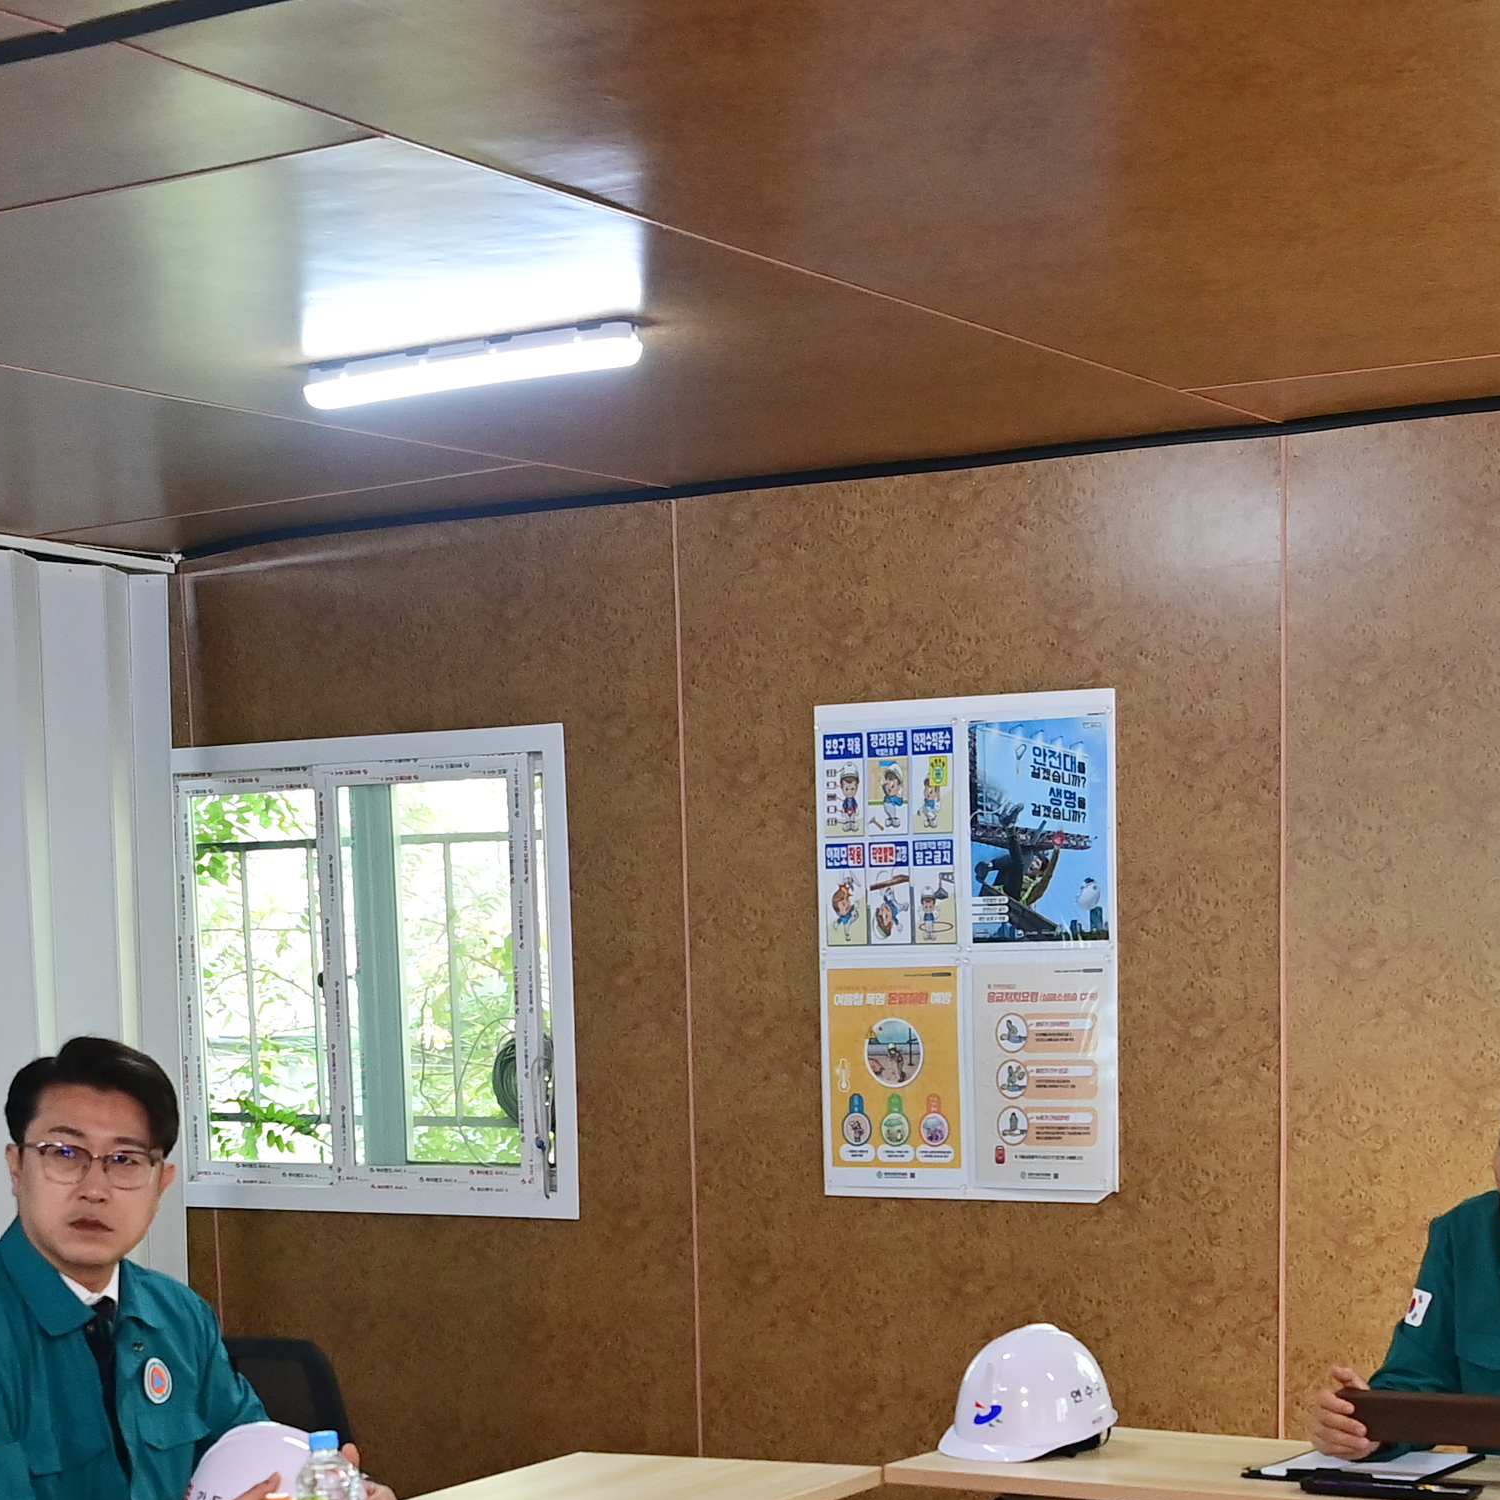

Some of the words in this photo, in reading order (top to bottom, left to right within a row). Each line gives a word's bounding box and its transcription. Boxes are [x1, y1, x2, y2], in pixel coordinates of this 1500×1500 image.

[825, 738, 845, 755] 보호구
[847, 737, 861, 755] 착용
[870, 732, 904, 748] 정리정돈
[914, 732, 950, 751] 안전수칙준수
[1032, 746, 1085, 774] 안전대를
[1049, 787, 1086, 809] 생명을
[827, 847, 848, 867] 안전모
[849, 846, 862, 865] 착용
[915, 851, 950, 864] 접근금지
